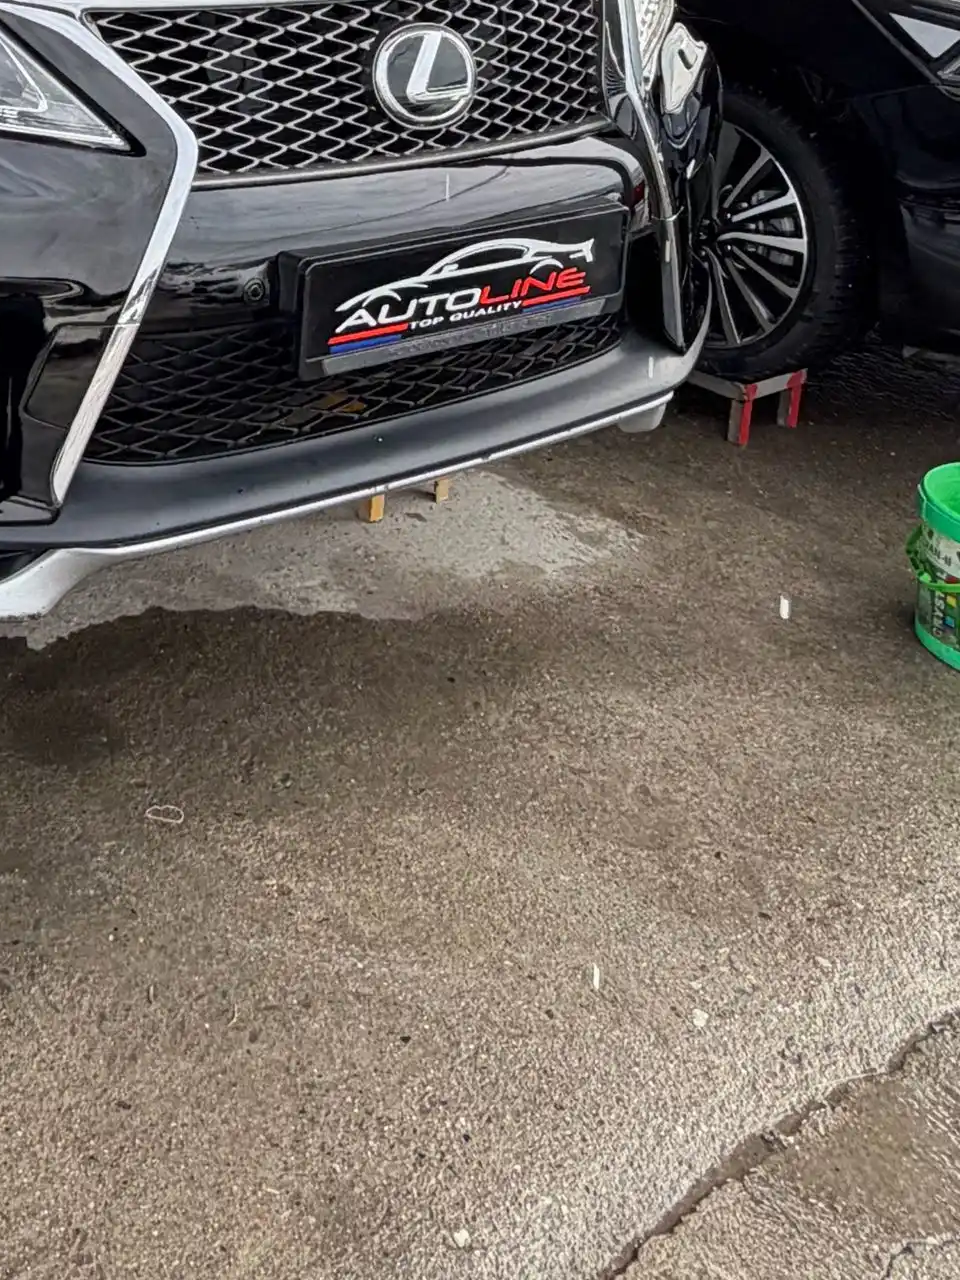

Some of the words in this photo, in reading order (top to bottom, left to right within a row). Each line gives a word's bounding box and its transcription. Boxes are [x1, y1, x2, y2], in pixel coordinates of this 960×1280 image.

[334, 267, 587, 334] AUTOLINE
[409, 316, 445, 330] TOP
[449, 300, 522, 322] QUALITY
